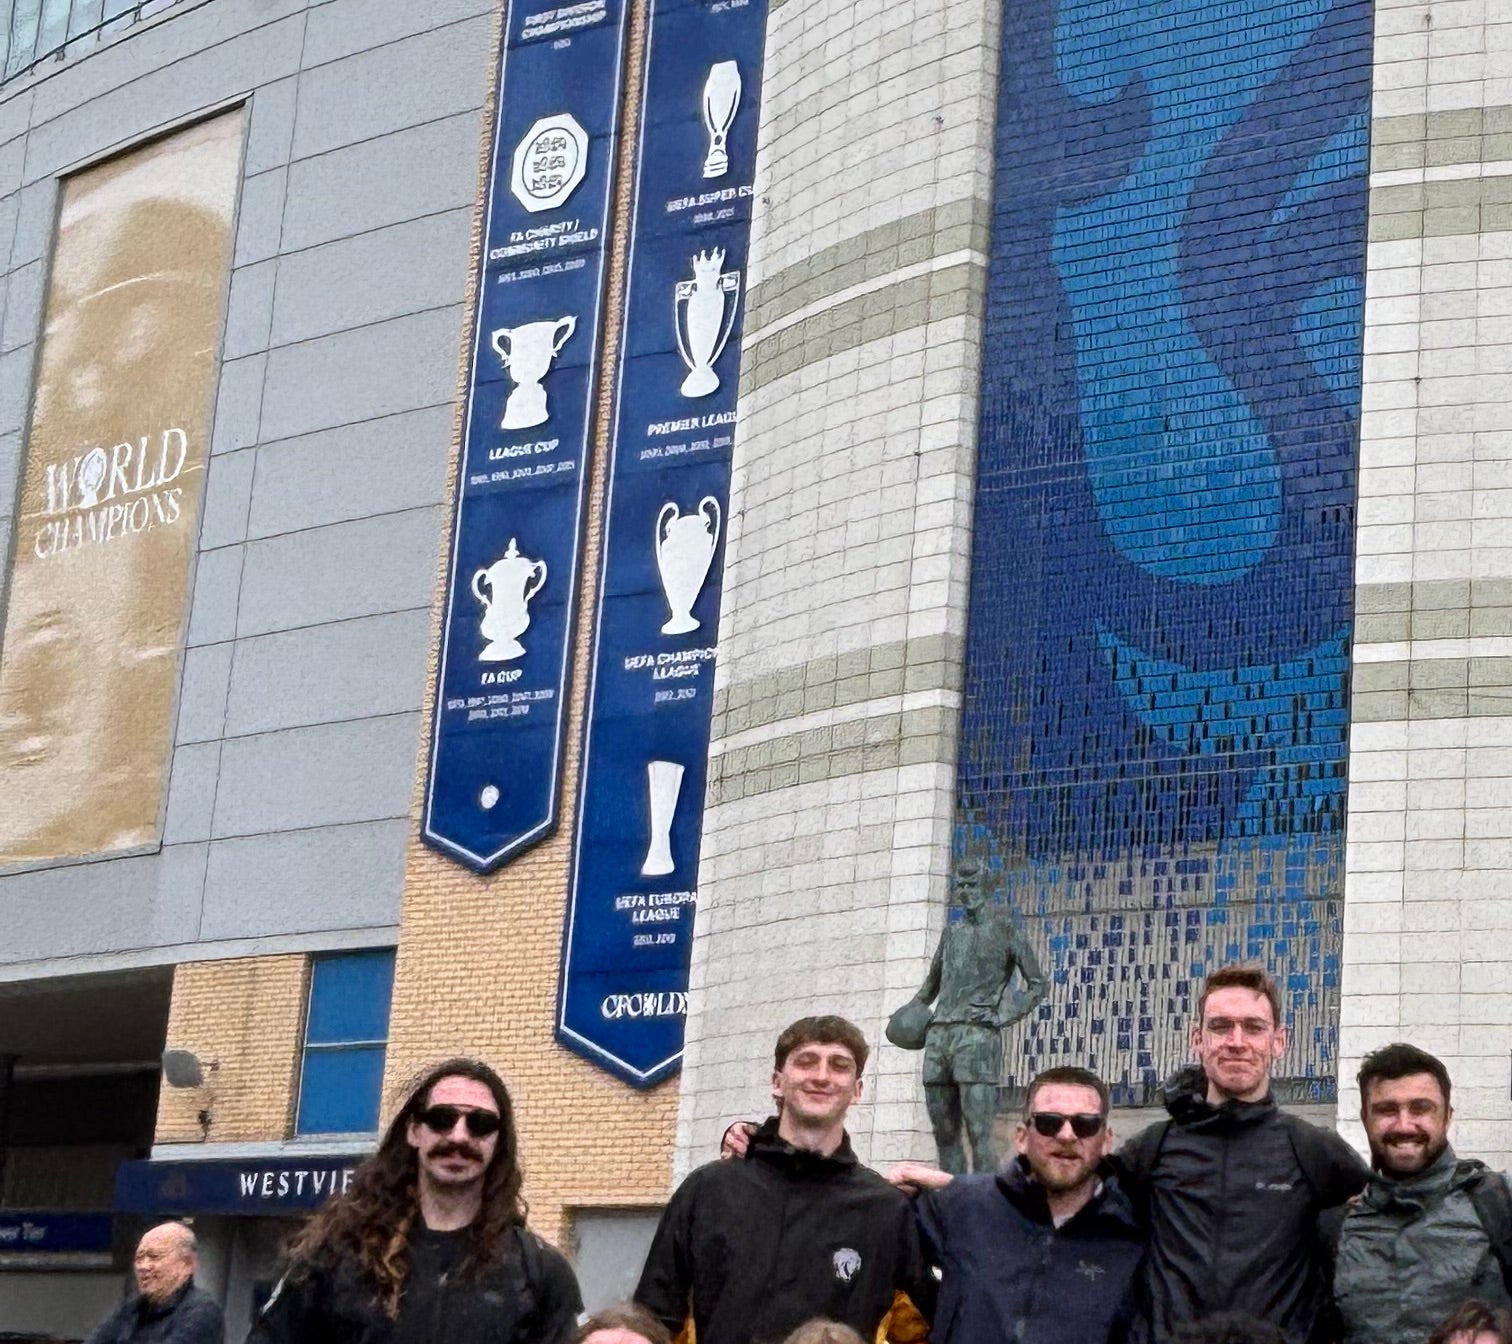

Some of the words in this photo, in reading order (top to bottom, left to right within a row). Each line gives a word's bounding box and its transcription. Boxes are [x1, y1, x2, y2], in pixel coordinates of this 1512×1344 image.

[47, 428, 188, 515] WORLD
[35, 487, 183, 559] CHAMPIONS
[601, 993, 643, 1018] CFC
[240, 1169, 356, 1197] WESTVIE
